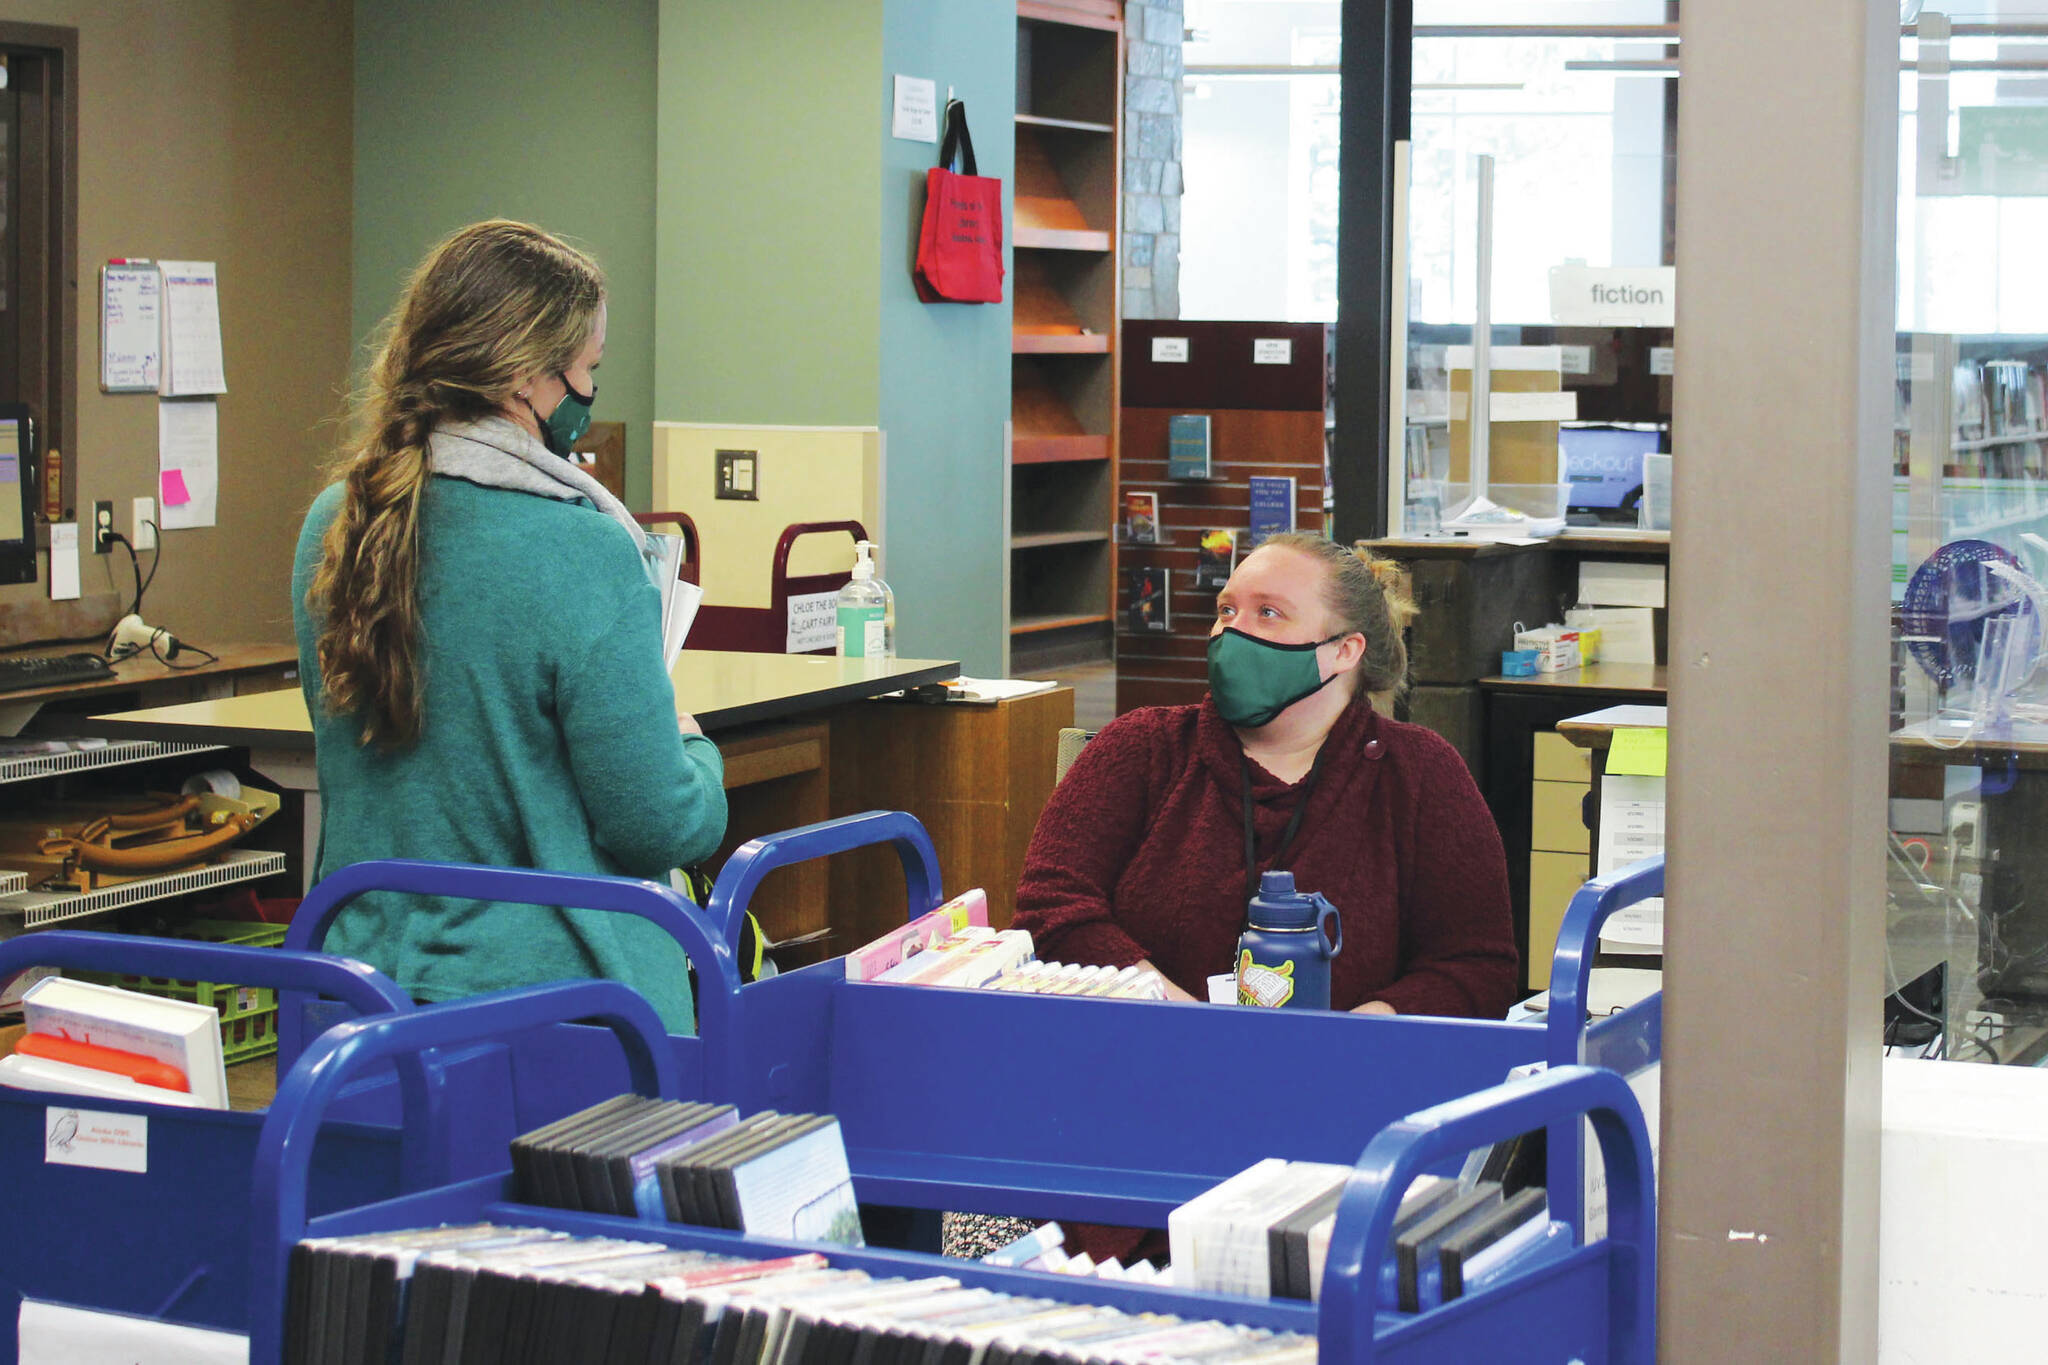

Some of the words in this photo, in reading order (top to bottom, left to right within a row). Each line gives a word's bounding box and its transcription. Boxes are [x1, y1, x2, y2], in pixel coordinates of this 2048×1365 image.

[1592, 284, 1664, 304] fiction
[1569, 452, 1635, 472] eckout
[793, 601, 814, 614] CHLOE
[816, 599, 828, 611] THE
[801, 617, 818, 630] CART
